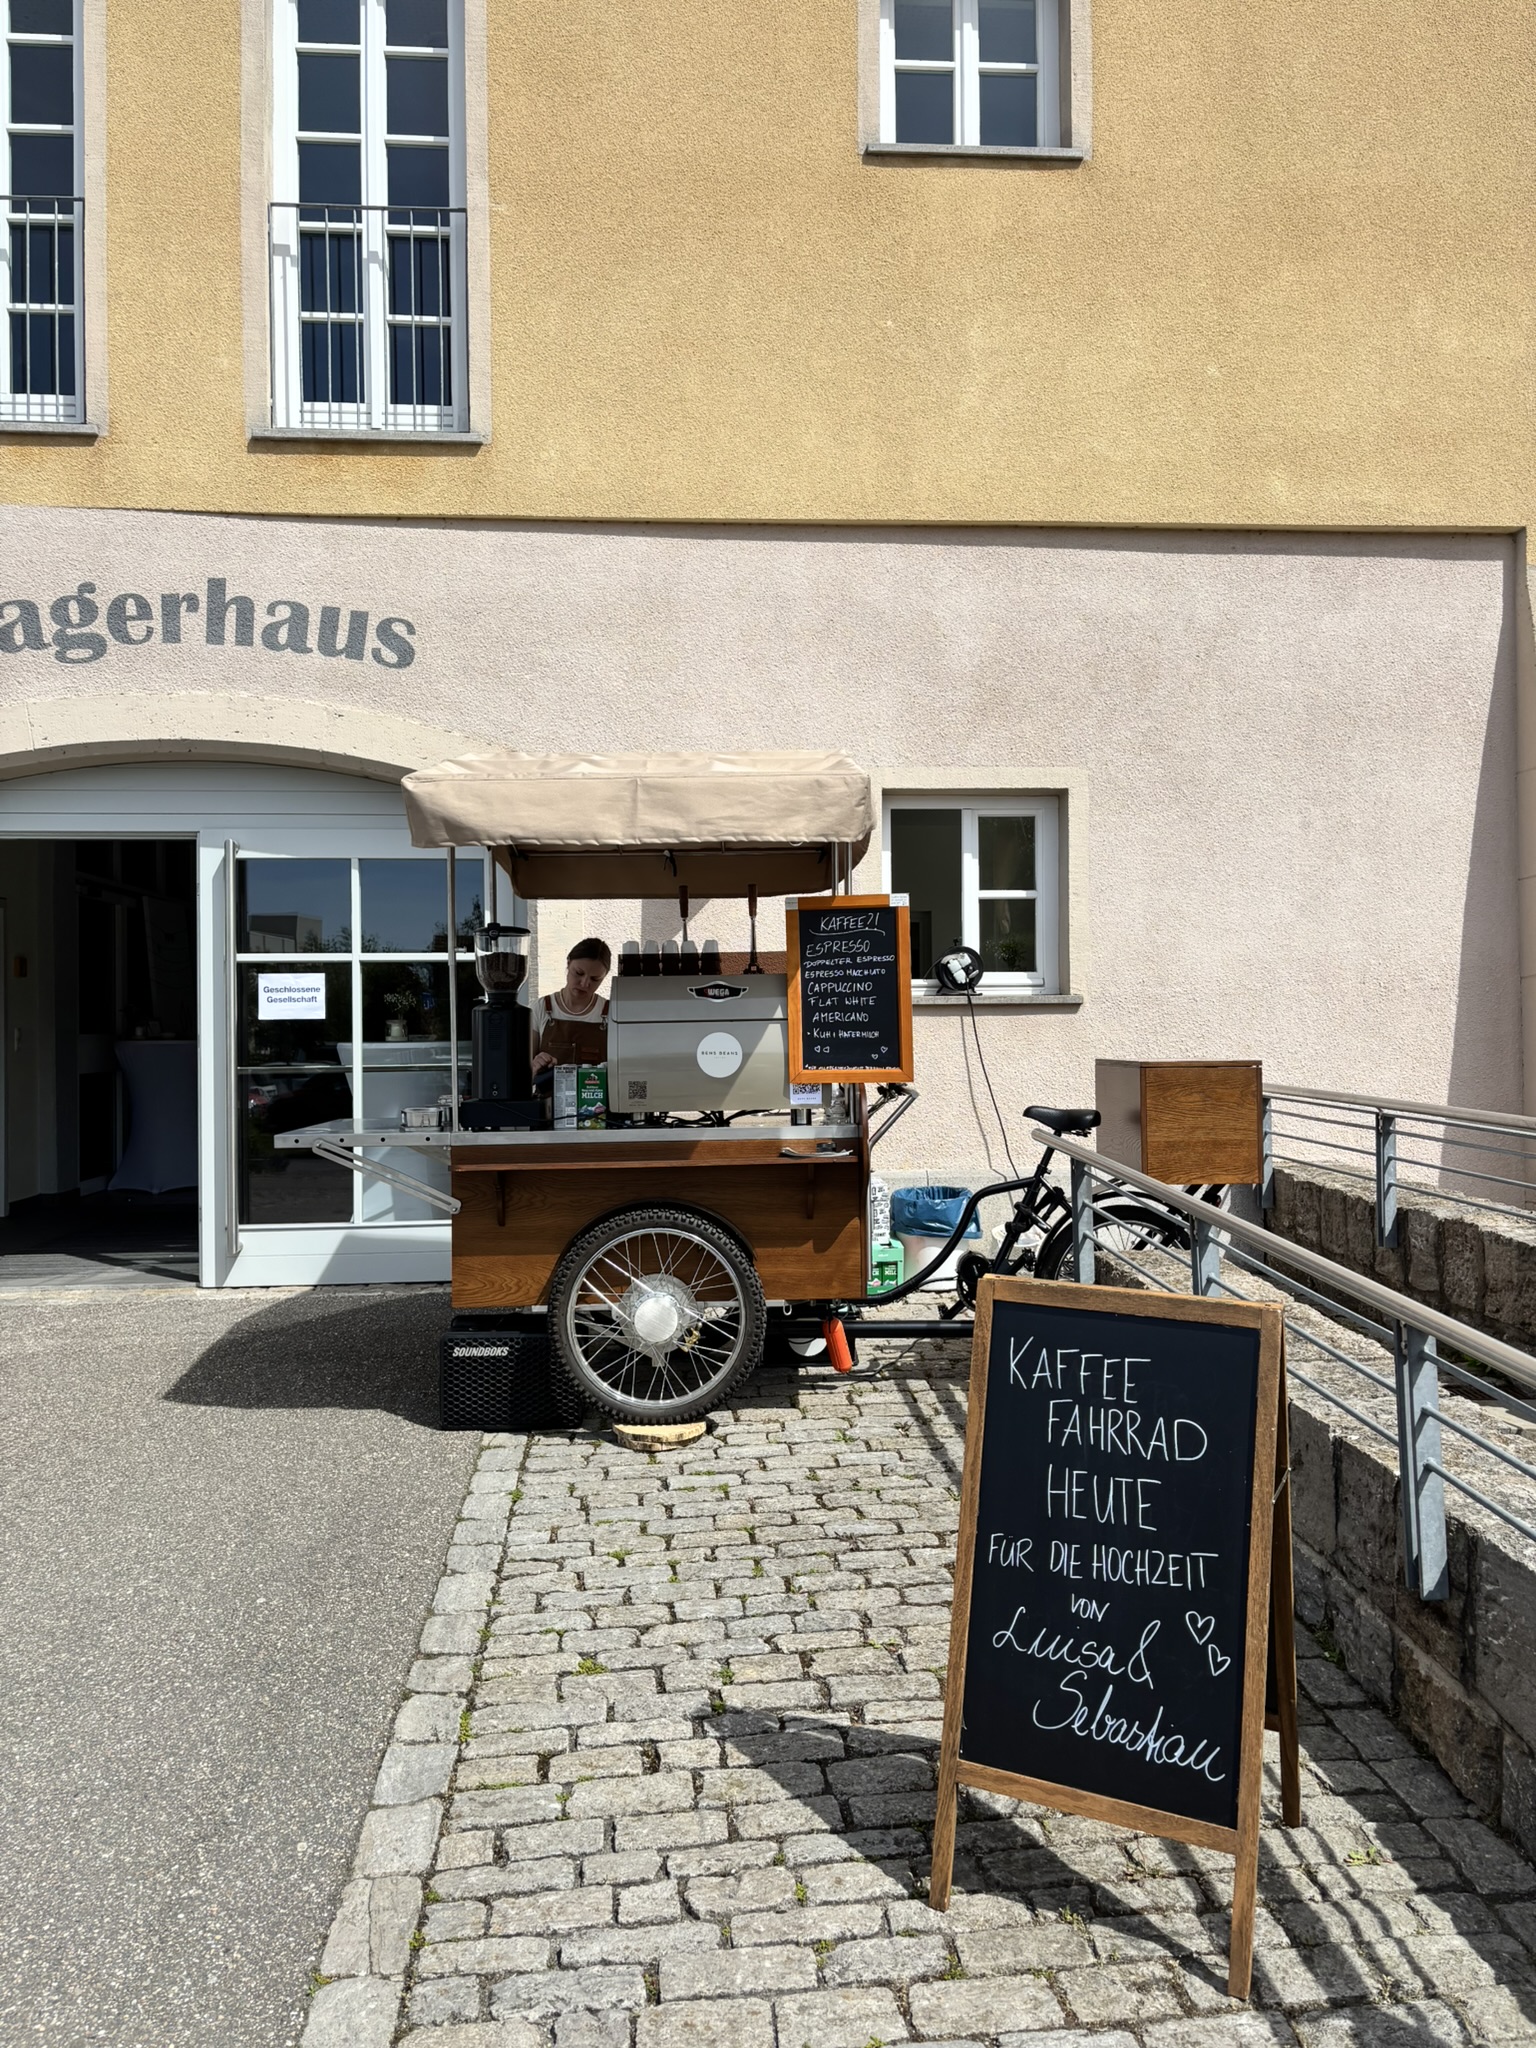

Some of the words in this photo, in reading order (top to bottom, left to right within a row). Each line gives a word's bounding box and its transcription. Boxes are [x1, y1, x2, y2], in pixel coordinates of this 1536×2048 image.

[0, 577, 417, 670] agerhaus
[806, 939, 871, 957] ESPRESSO
[803, 957, 853, 968] DOPPELTER
[856, 955, 895, 963] ESPRESSO
[804, 970, 844, 979] ESPRESSO
[707, 988, 730, 996] WEGA
[807, 981, 873, 995] CAPPUCCINO
[807, 996, 839, 1007] FLAT
[844, 996, 877, 1006] WHITE
[812, 1011, 869, 1023] AMERICANO
[838, 1029, 880, 1038] HAFERMILCH
[452, 1347, 509, 1357] SOUNDBOKS
[1010, 1336, 1152, 1404] KAFFEE
[1048, 1399, 1208, 1461] FAHRRAD
[1047, 1463, 1162, 1531] HEUTE
[988, 1533, 1034, 1572] FÜR
[1050, 1540, 1083, 1579] DIE
[1091, 1543, 1219, 1591] HOCHZEIT
[993, 1606, 1126, 1675] Luisa
[1127, 1620, 1161, 1690] &
[1032, 1670, 1226, 1782] Sebastian
